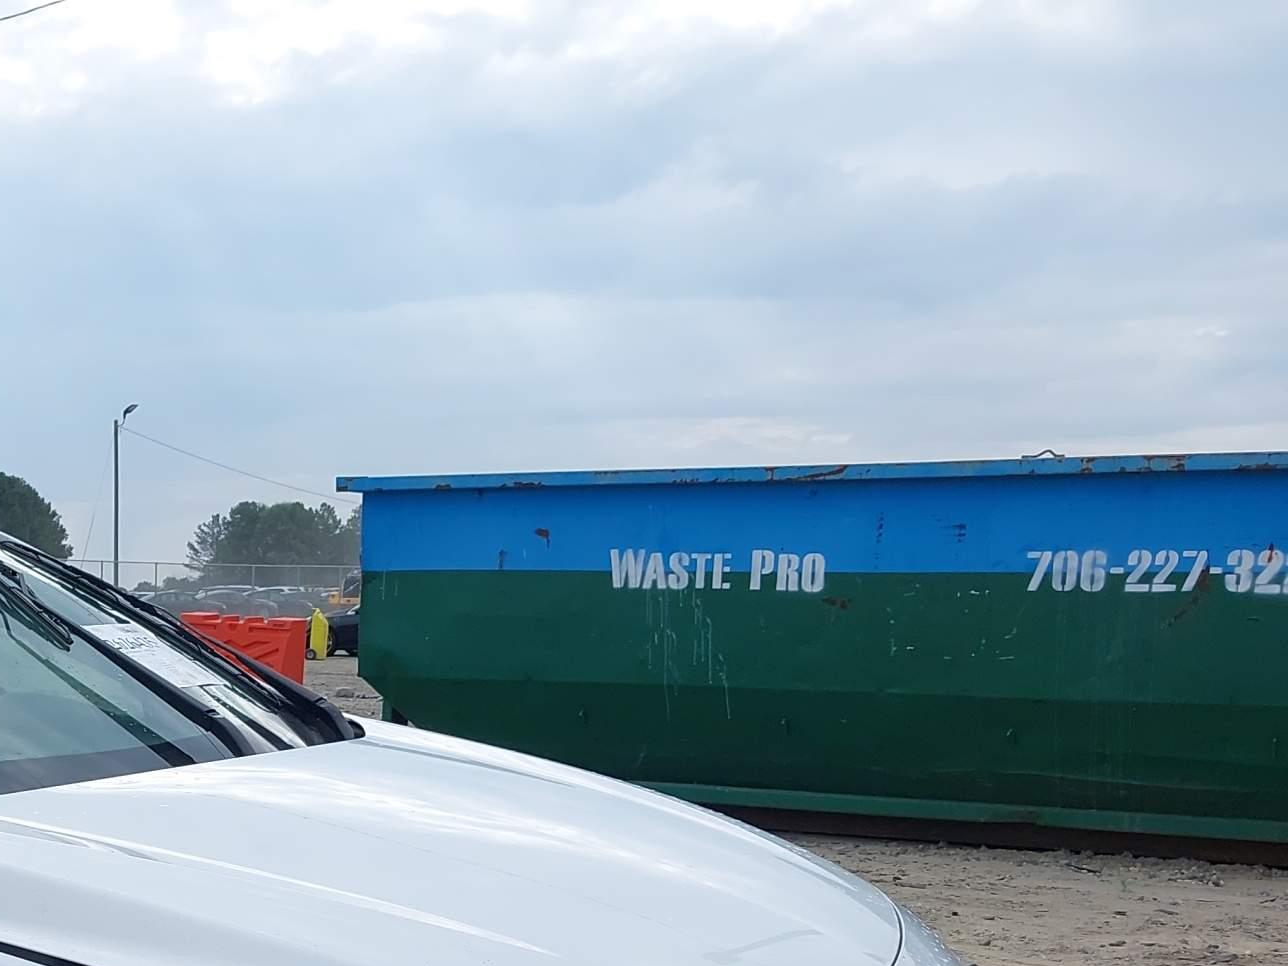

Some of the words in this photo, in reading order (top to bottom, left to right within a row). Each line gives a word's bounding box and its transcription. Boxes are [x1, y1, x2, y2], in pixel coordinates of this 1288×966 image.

[610, 549, 732, 589] WASTE
[749, 550, 826, 592] PRO
[1027, 550, 1288, 593] 706-227-32
